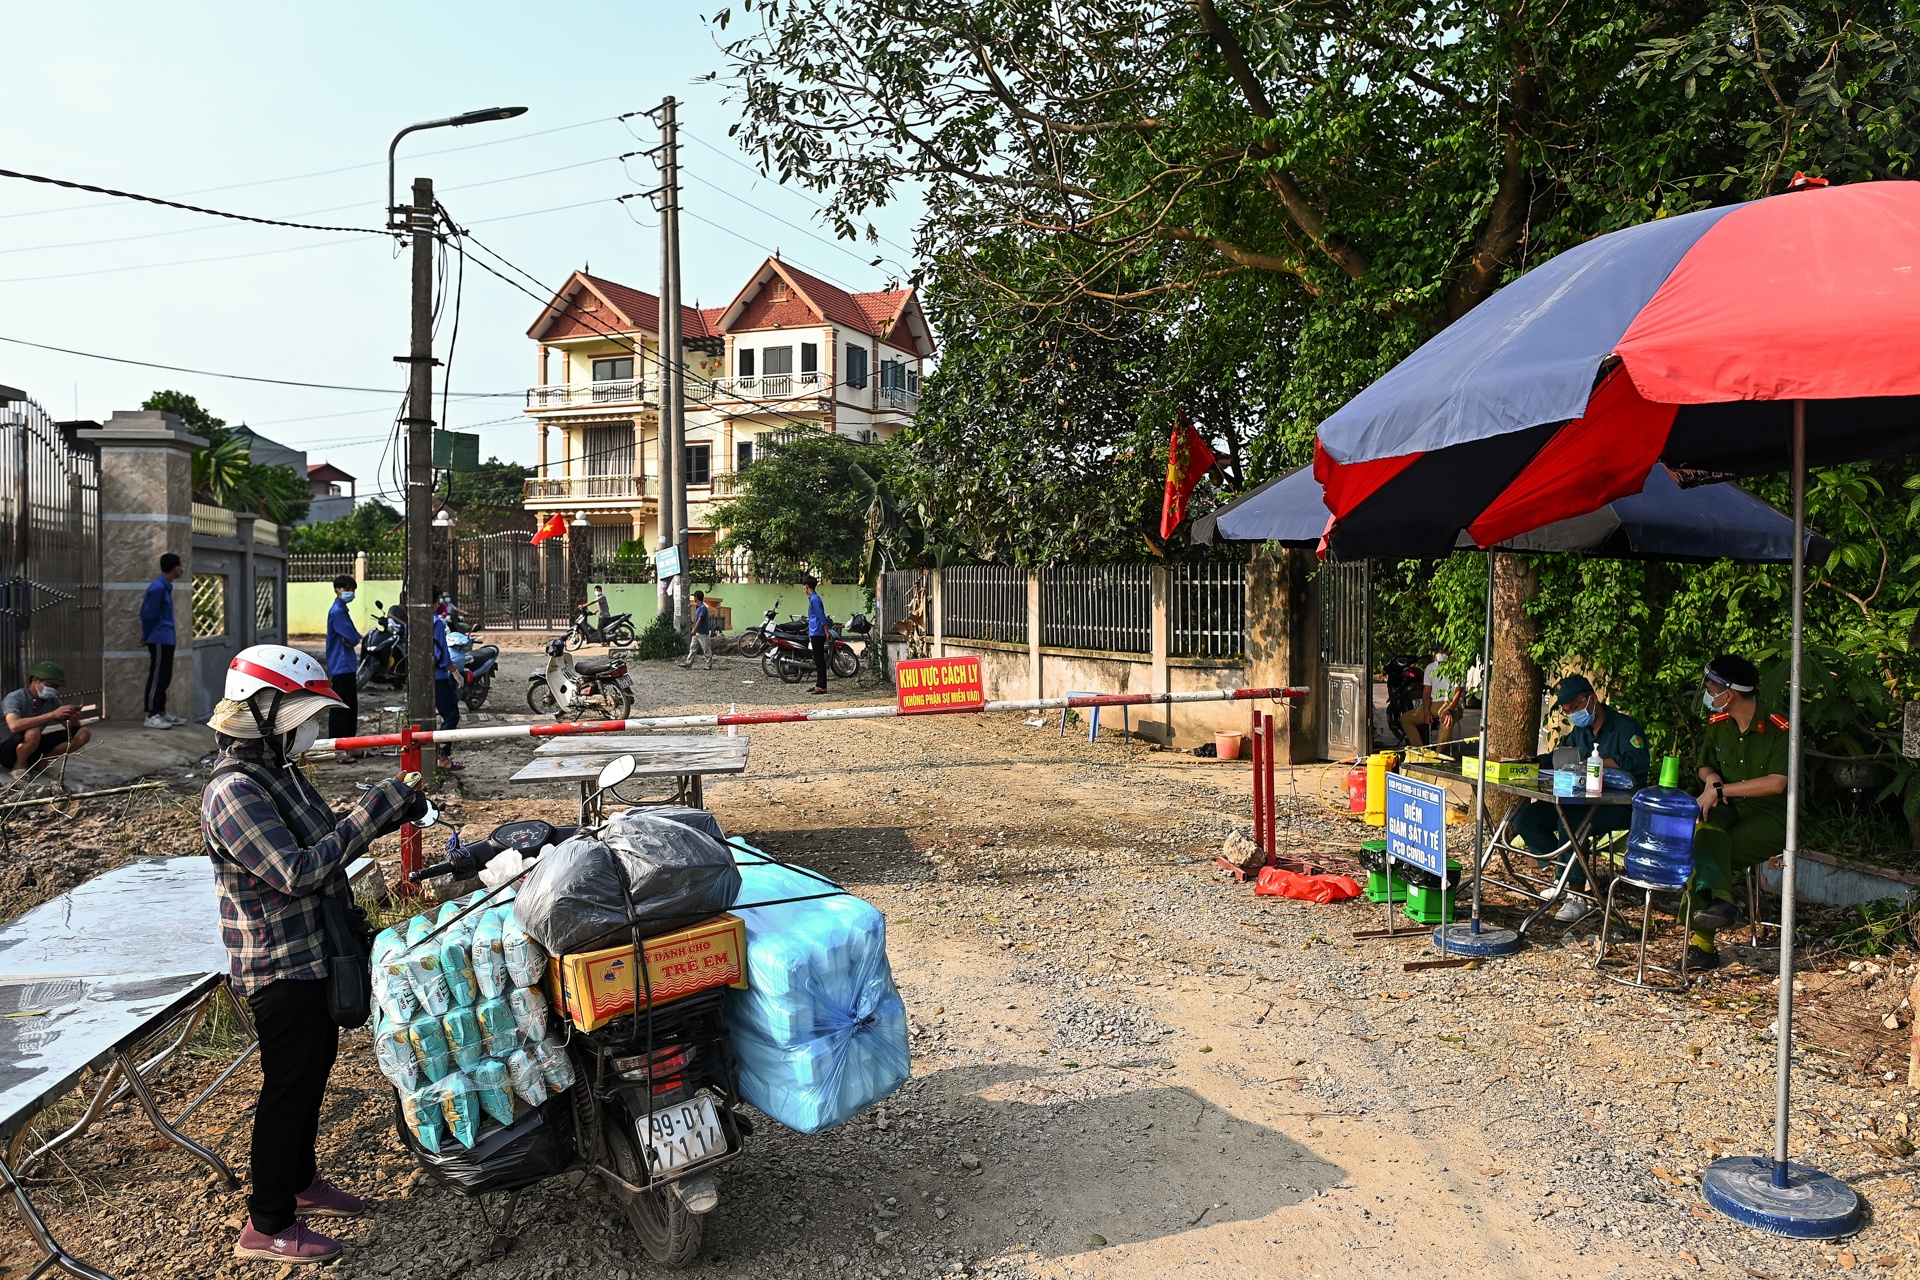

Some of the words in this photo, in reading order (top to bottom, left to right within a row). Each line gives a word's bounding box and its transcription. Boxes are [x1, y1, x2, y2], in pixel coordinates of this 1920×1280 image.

[899, 668, 919, 689] KHU
[920, 665, 940, 691] VỰC
[941, 662, 967, 686] CÁCH
[967, 663, 978, 683] LY
[903, 693, 925, 708] (KHÔNG
[1404, 800, 1422, 825] ĐIỂM
[1389, 816, 1407, 839] GIÁM
[1408, 823, 1422, 844] SÁT
[1423, 830, 1428, 847] Y
[1430, 830, 1439, 851] TẾ
[1392, 839, 1406, 856] PCD
[1406, 845, 1436, 869] COVID-19
[654, 948, 686, 962] DÀNH
[689, 941, 711, 955] CHO
[661, 956, 699, 978] TRẺ
[702, 951, 729, 968] EM
[652, 1103, 705, 1139] 99-D1
